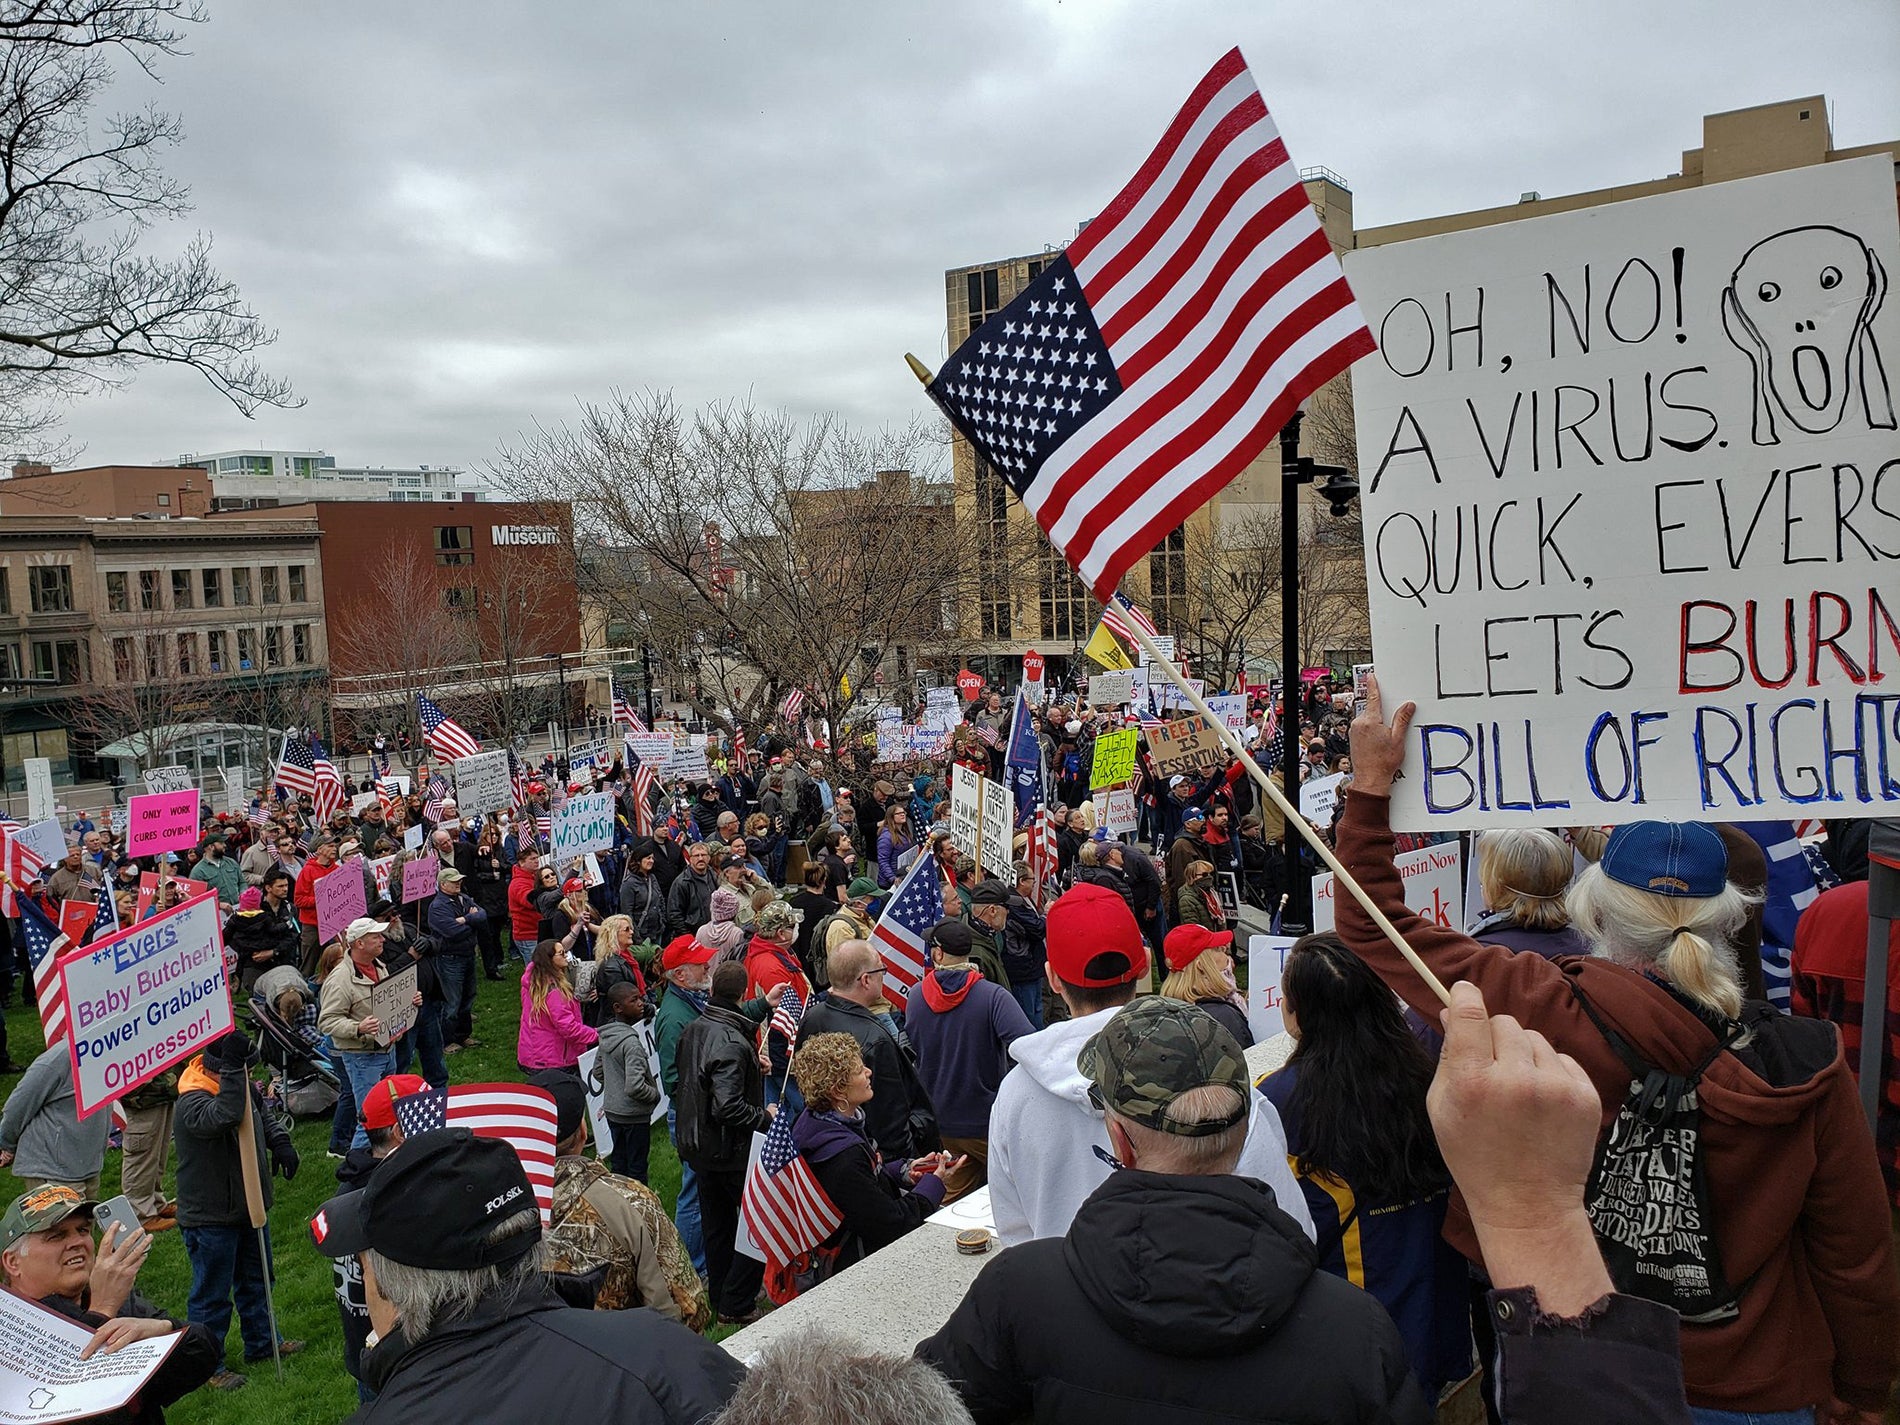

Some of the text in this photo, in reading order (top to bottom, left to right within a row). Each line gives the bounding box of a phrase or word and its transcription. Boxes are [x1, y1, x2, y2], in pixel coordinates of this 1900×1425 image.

[1380, 247, 1687, 378] OH, NO!
[1369, 366, 1728, 494] A VIRUS.
[491, 525, 560, 545] Museum
[1376, 492, 1594, 608] QUICK,
[1023, 658, 1043, 668] OPEN
[1436, 607, 1634, 700] LET'S
[960, 678, 980, 688] OPEN
[1151, 716, 1213, 745] FREEDOM
[1227, 714, 1245, 727] FREE
[1176, 735, 1200, 753] IS
[1415, 693, 1900, 815] BILL OF RIGHT
[571, 755, 595, 770] OPEN
[1157, 745, 1225, 776] ESSENTIAL
[145, 767, 189, 781] CREATED
[143, 805, 191, 820] ONLY WORK
[593, 798, 606, 812] UP
[1111, 800, 1132, 813] back
[134, 825, 192, 843] CURES COVID-19
[323, 893, 356, 921] Wisconsin
[77, 936, 216, 1028] Baby Butcher!
[373, 974, 416, 1006] REMEMBER
[390, 997, 402, 1011] IN
[74, 965, 226, 1068] Power Grabber!
[103, 1008, 212, 1089] Oppressor!
[1636, 1261, 1674, 1281] ONTARIO
[26, 1322, 48, 1338] SHALL
[48, 1333, 70, 1348] MAKE
[70, 1343, 81, 1353] NO
[37, 1338, 48, 1346] OF
[11, 1345, 22, 1353] OR
[23, 1350, 34, 1358] OF
[34, 1355, 48, 1366] THE
[27, 1342, 59, 1362] THEREOF;
[60, 1358, 71, 1366] OR
[24, 1370, 40, 1380] FOR
[33, 1364, 44, 1373] TO
